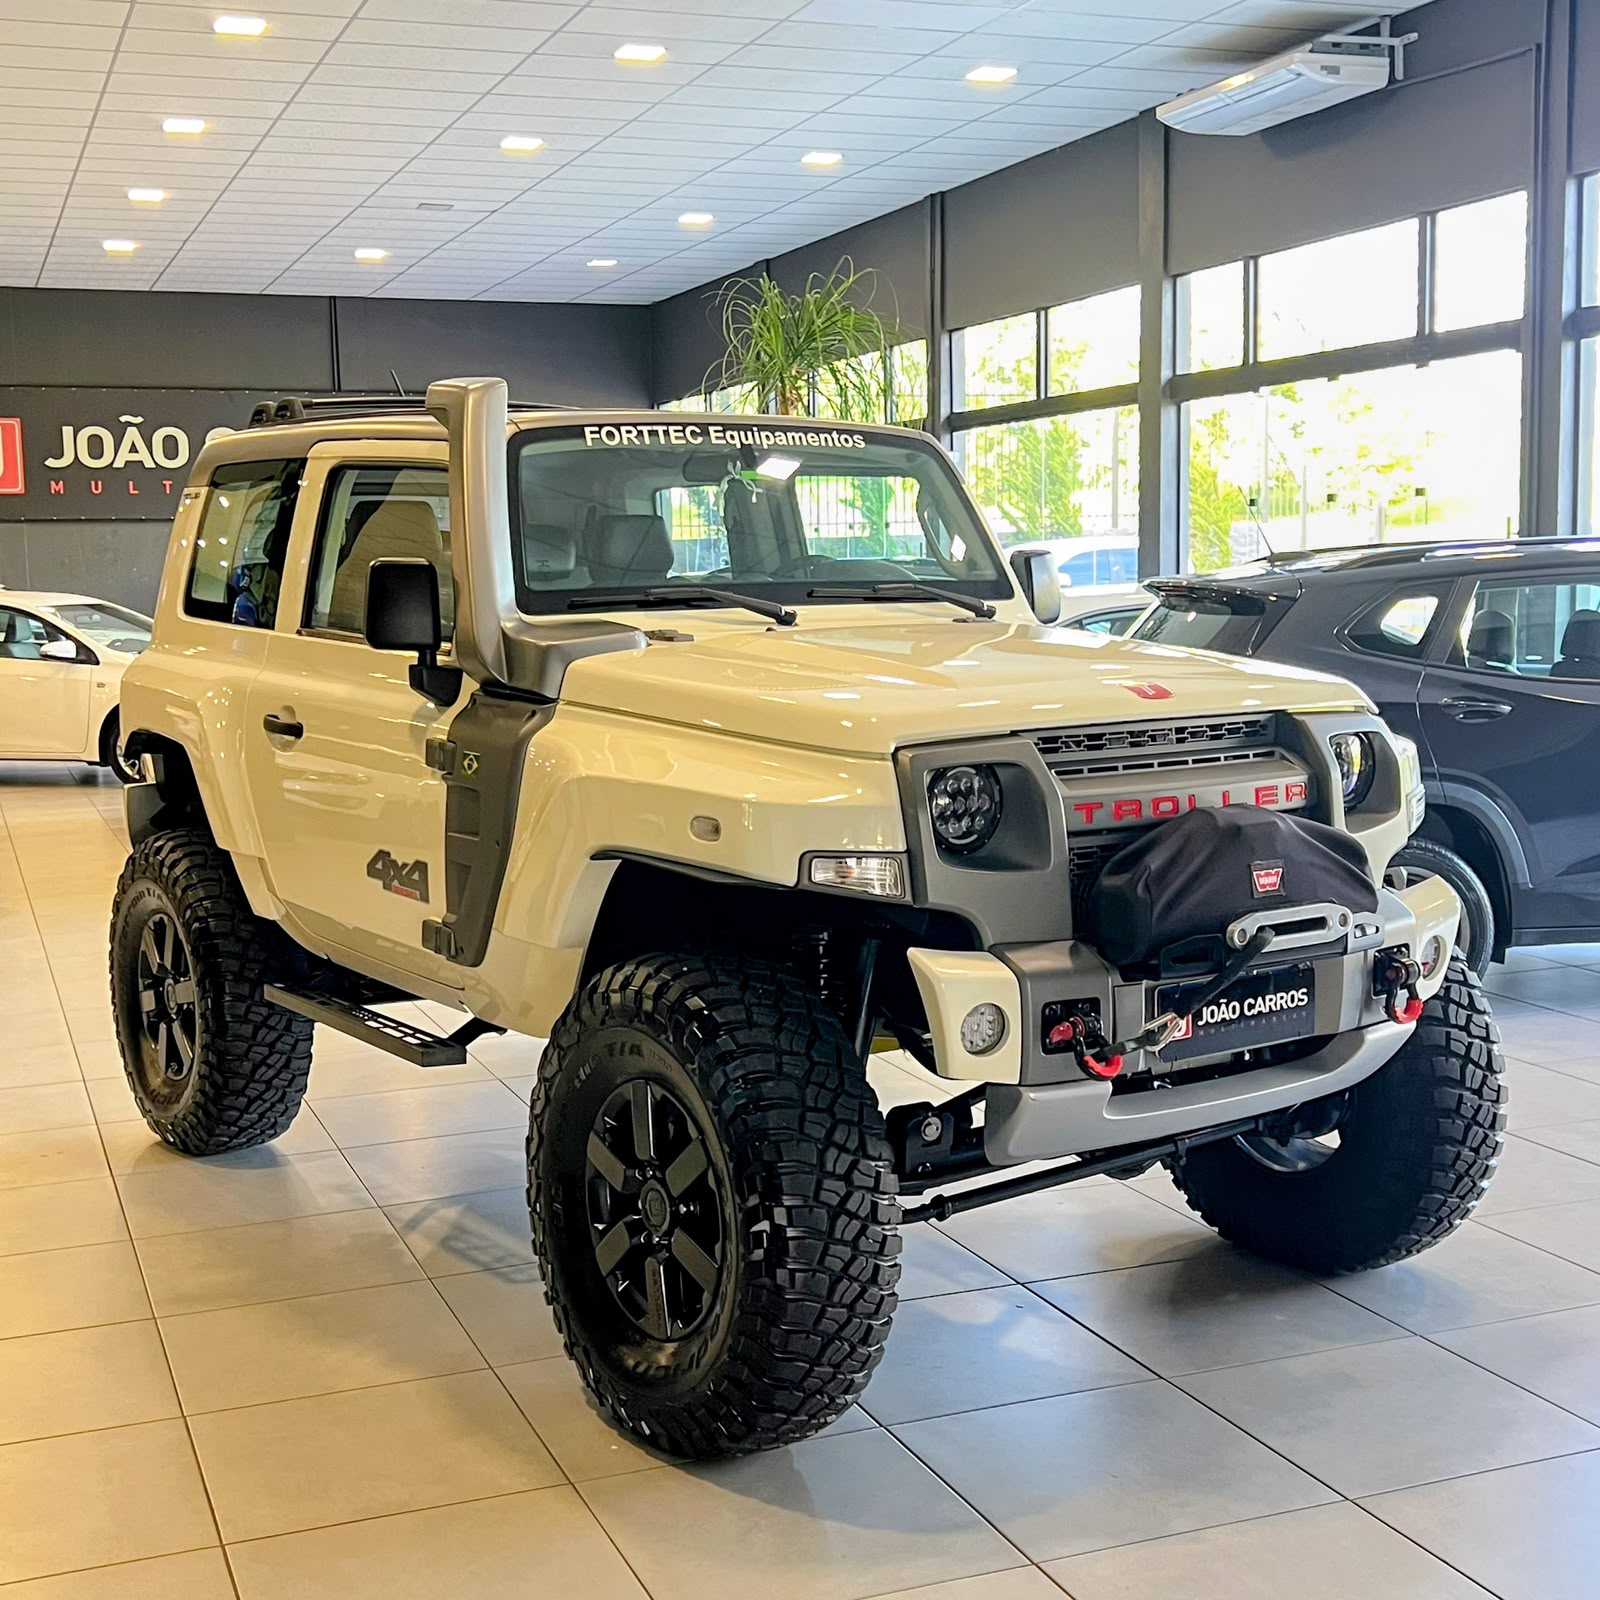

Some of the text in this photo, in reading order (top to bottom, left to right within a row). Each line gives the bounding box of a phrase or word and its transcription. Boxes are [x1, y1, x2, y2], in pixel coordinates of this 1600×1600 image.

[44, 414, 190, 469] JOÃO
[584, 425, 866, 449] FORTTEC Equipamentos
[1197, 988, 1309, 1026] JOÃO CARROS
